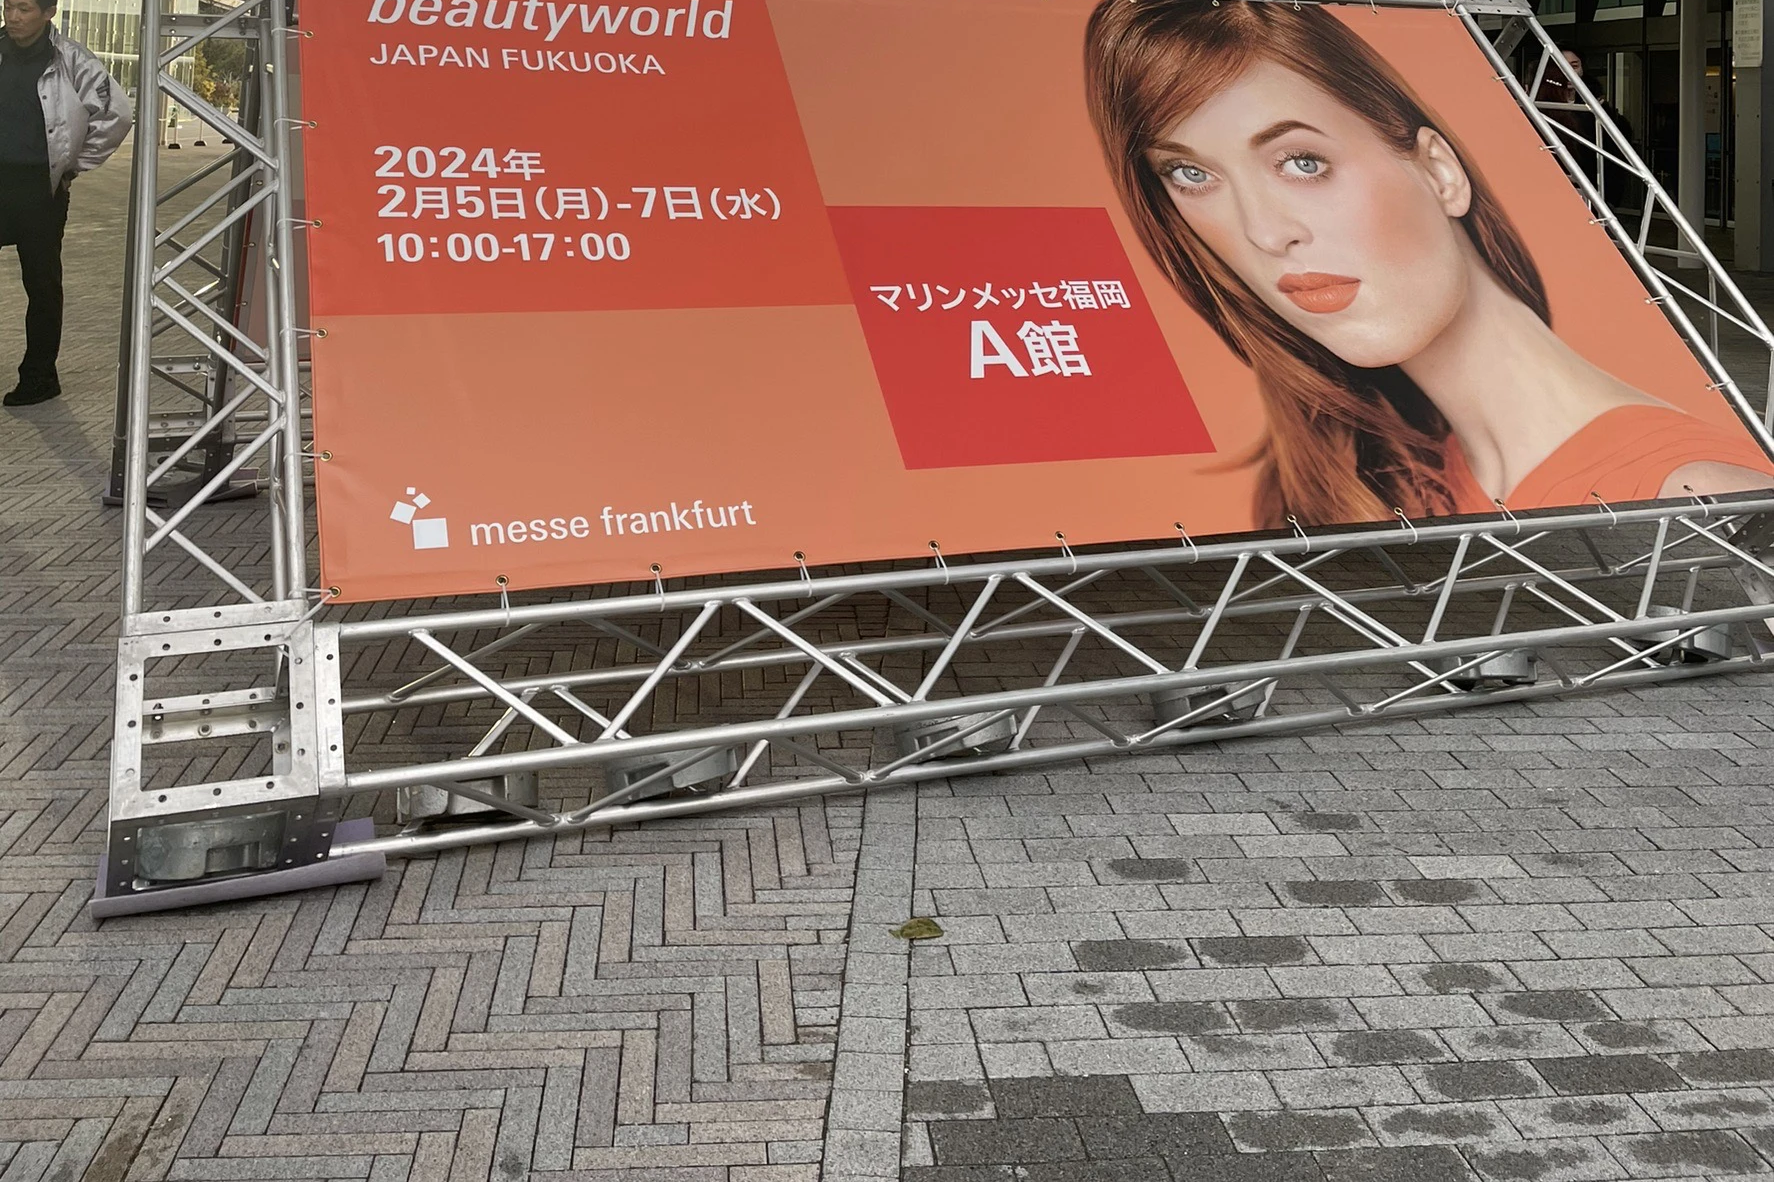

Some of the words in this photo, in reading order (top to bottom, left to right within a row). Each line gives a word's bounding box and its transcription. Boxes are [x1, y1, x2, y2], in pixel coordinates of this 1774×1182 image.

[369, 43, 490, 69] JAPAN
[501, 48, 666, 75] FUKUOKA
[374, 145, 546, 181] 2024年
[868, 279, 1131, 312] マリンメッセ福岡
[970, 319, 1093, 379] A館
[470, 516, 590, 547] messe
[599, 499, 757, 536] frankfurt
